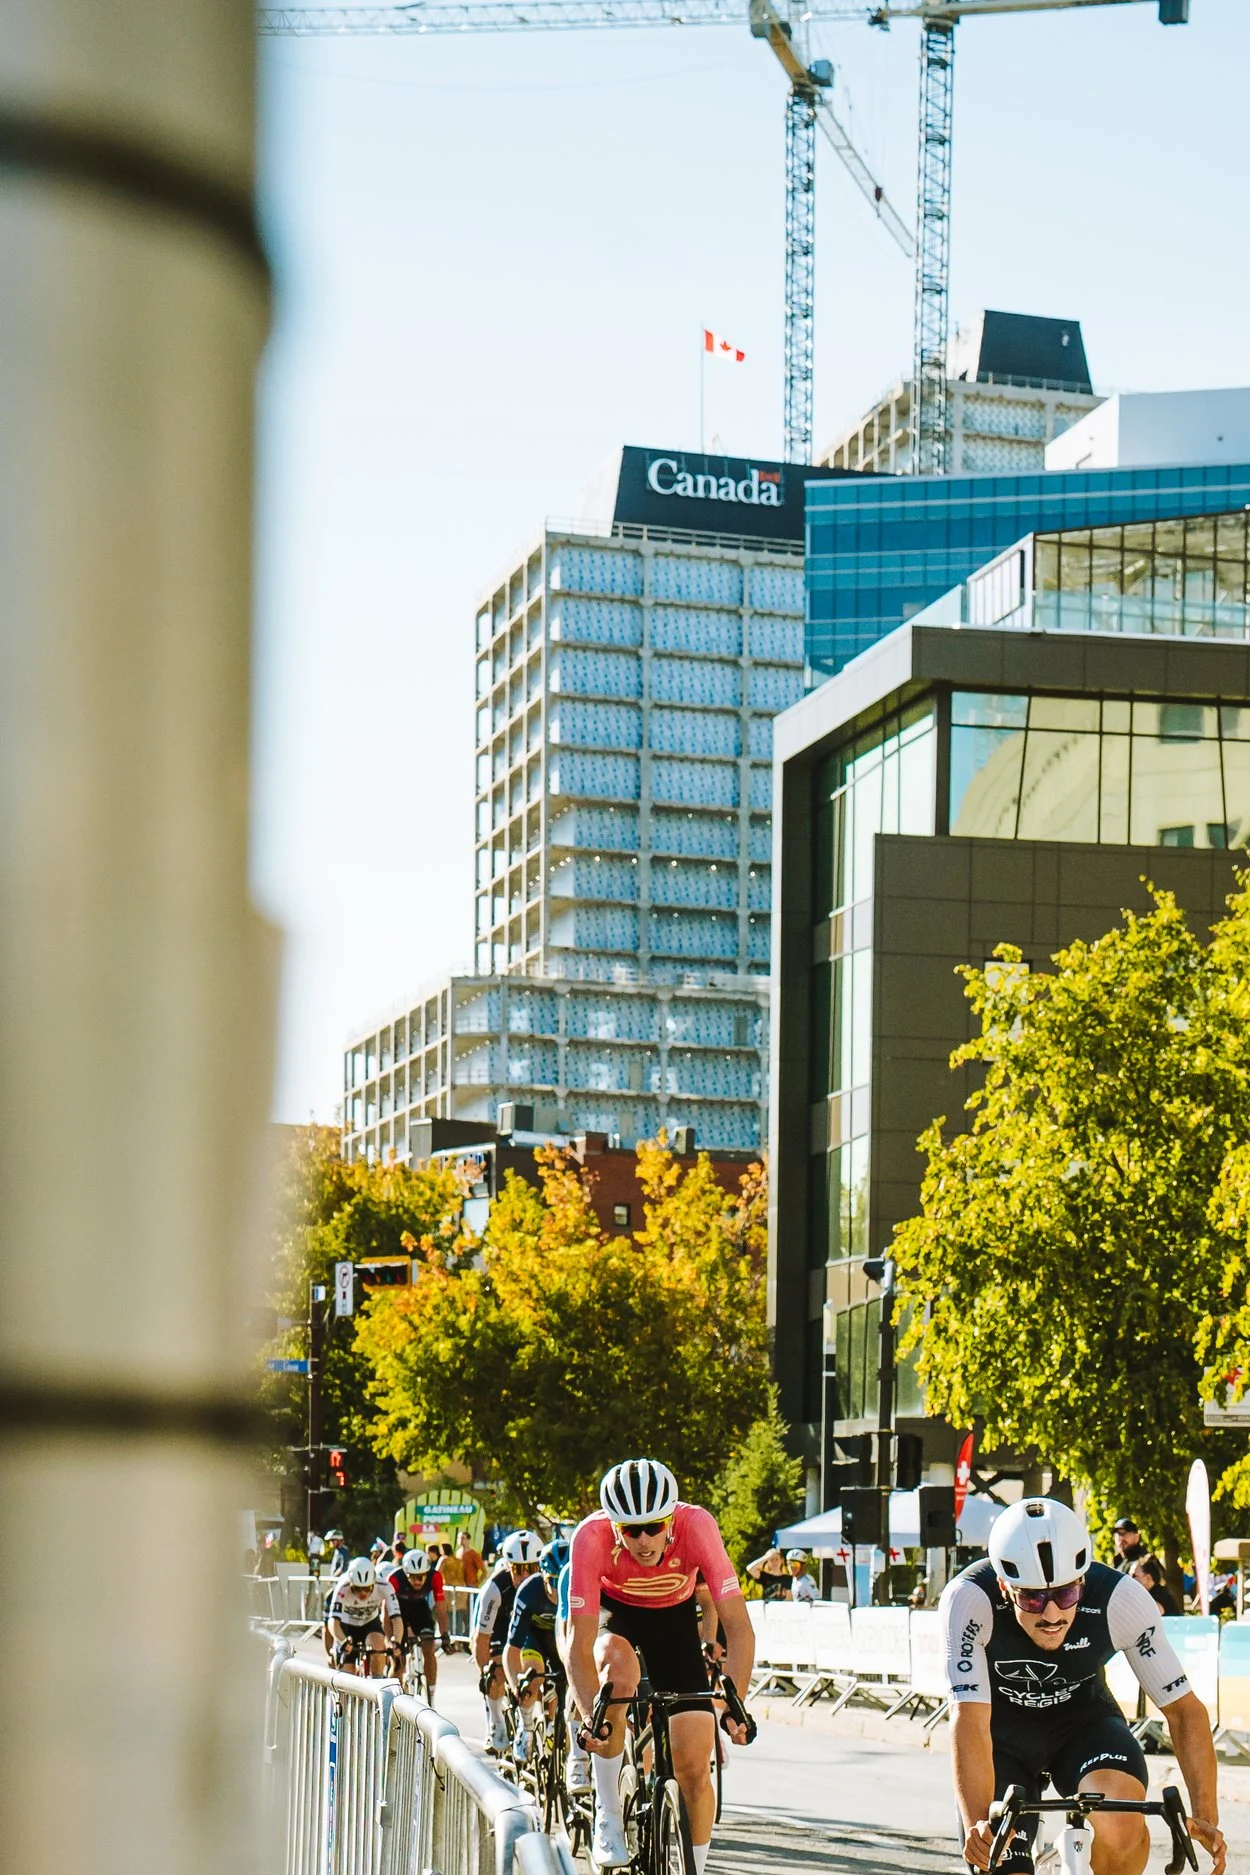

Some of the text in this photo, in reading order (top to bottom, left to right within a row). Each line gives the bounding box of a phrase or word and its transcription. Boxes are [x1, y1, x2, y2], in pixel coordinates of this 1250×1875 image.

[648, 458, 782, 507] Canada
[998, 1683, 1081, 1700] CYCLES
[1009, 1693, 1072, 1709] REGIS
